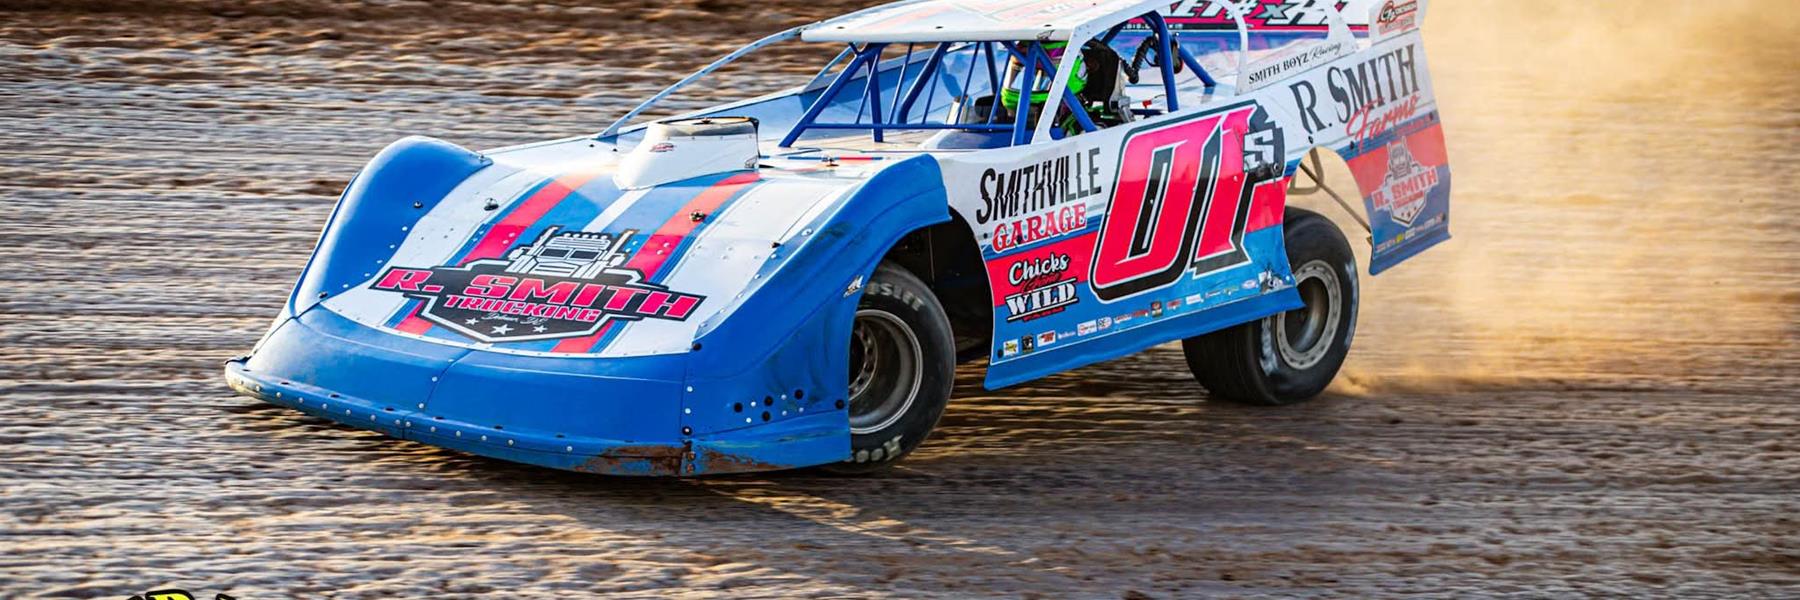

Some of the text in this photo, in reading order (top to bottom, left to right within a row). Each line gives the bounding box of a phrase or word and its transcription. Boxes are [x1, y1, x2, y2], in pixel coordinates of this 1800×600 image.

[1248, 63, 1281, 84] SMITH
[1283, 52, 1310, 72] BOYZ
[1289, 43, 1420, 134] R. SMITH
[1345, 93, 1420, 153] Farms
[976, 146, 1102, 225] SMITHVILLE
[1391, 168, 1437, 198] SMITH
[992, 202, 1088, 253] GARAGE
[1008, 252, 1071, 287] Chicks
[377, 267, 701, 318] R. SMITH
[443, 294, 603, 323] TRUCKING
[1006, 281, 1079, 318] WILD
